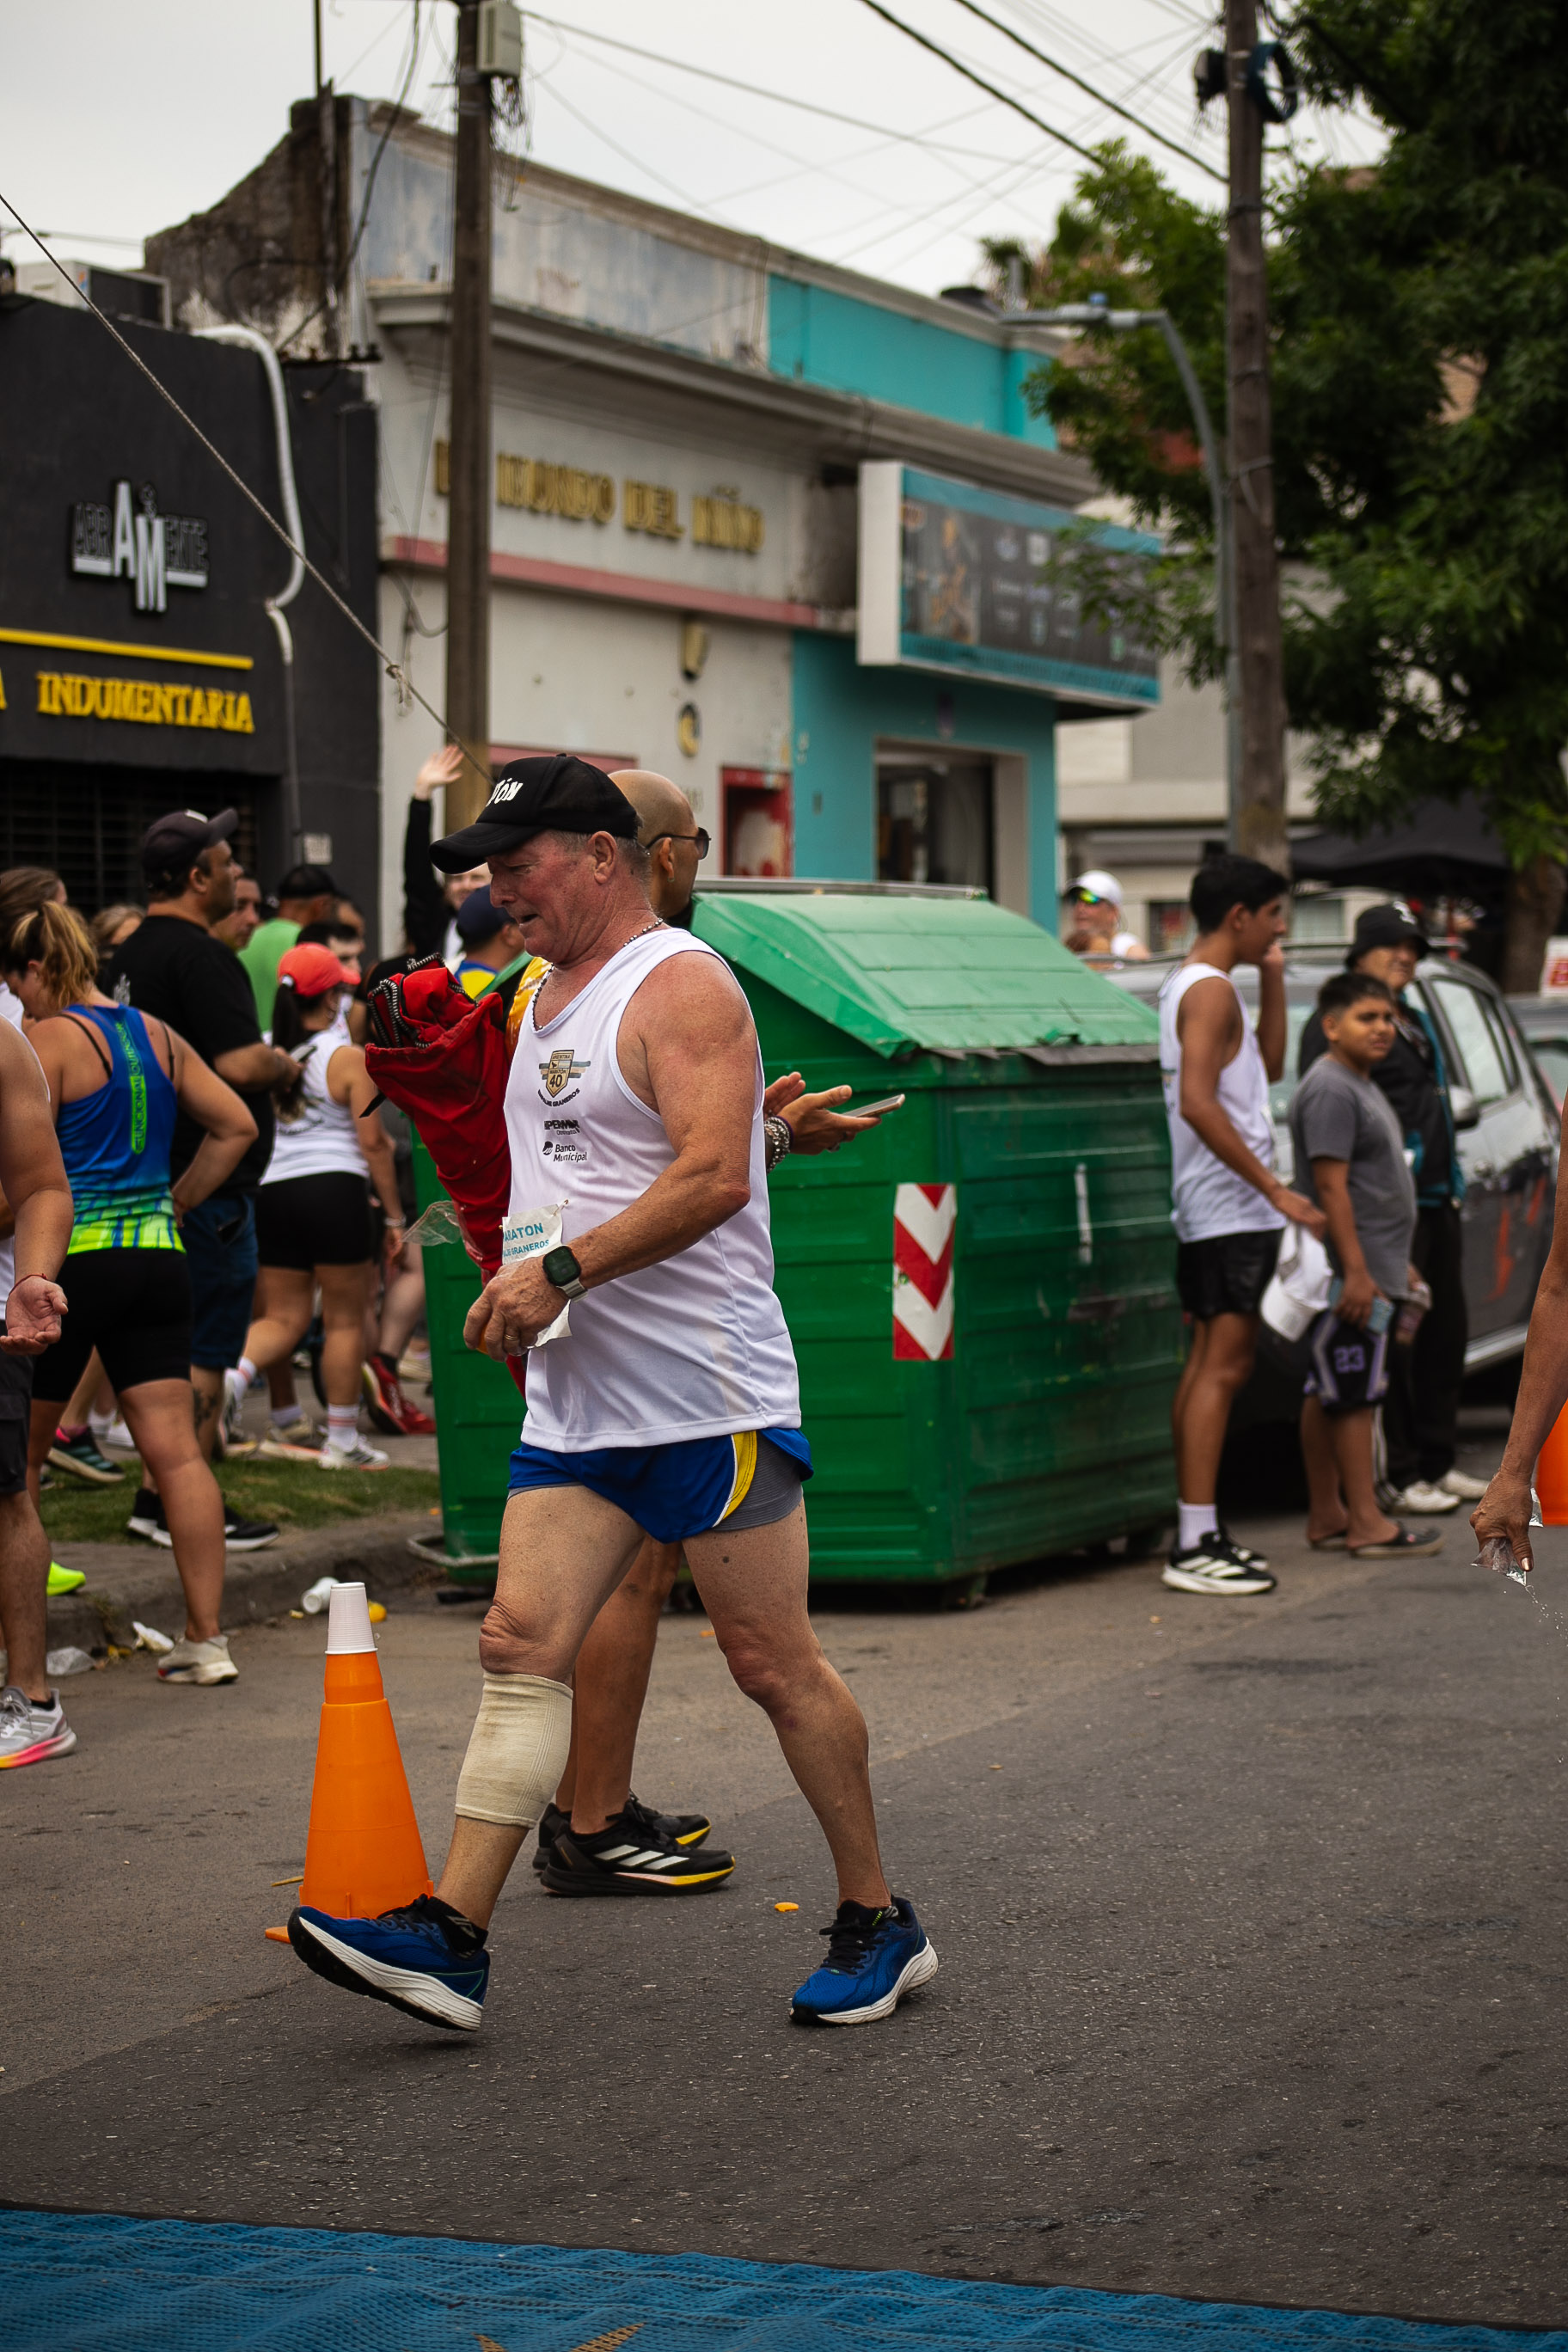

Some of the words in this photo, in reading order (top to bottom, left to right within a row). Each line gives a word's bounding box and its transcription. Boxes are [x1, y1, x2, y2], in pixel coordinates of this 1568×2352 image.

[36, 671, 254, 734] INDUMENTARIA
[548, 1074, 563, 1088] 40
[553, 1152, 587, 1163] Municipal
[554, 1144, 576, 1154] Banco
[504, 1222, 544, 1242] ARATON
[1334, 1345, 1366, 1374] 23
